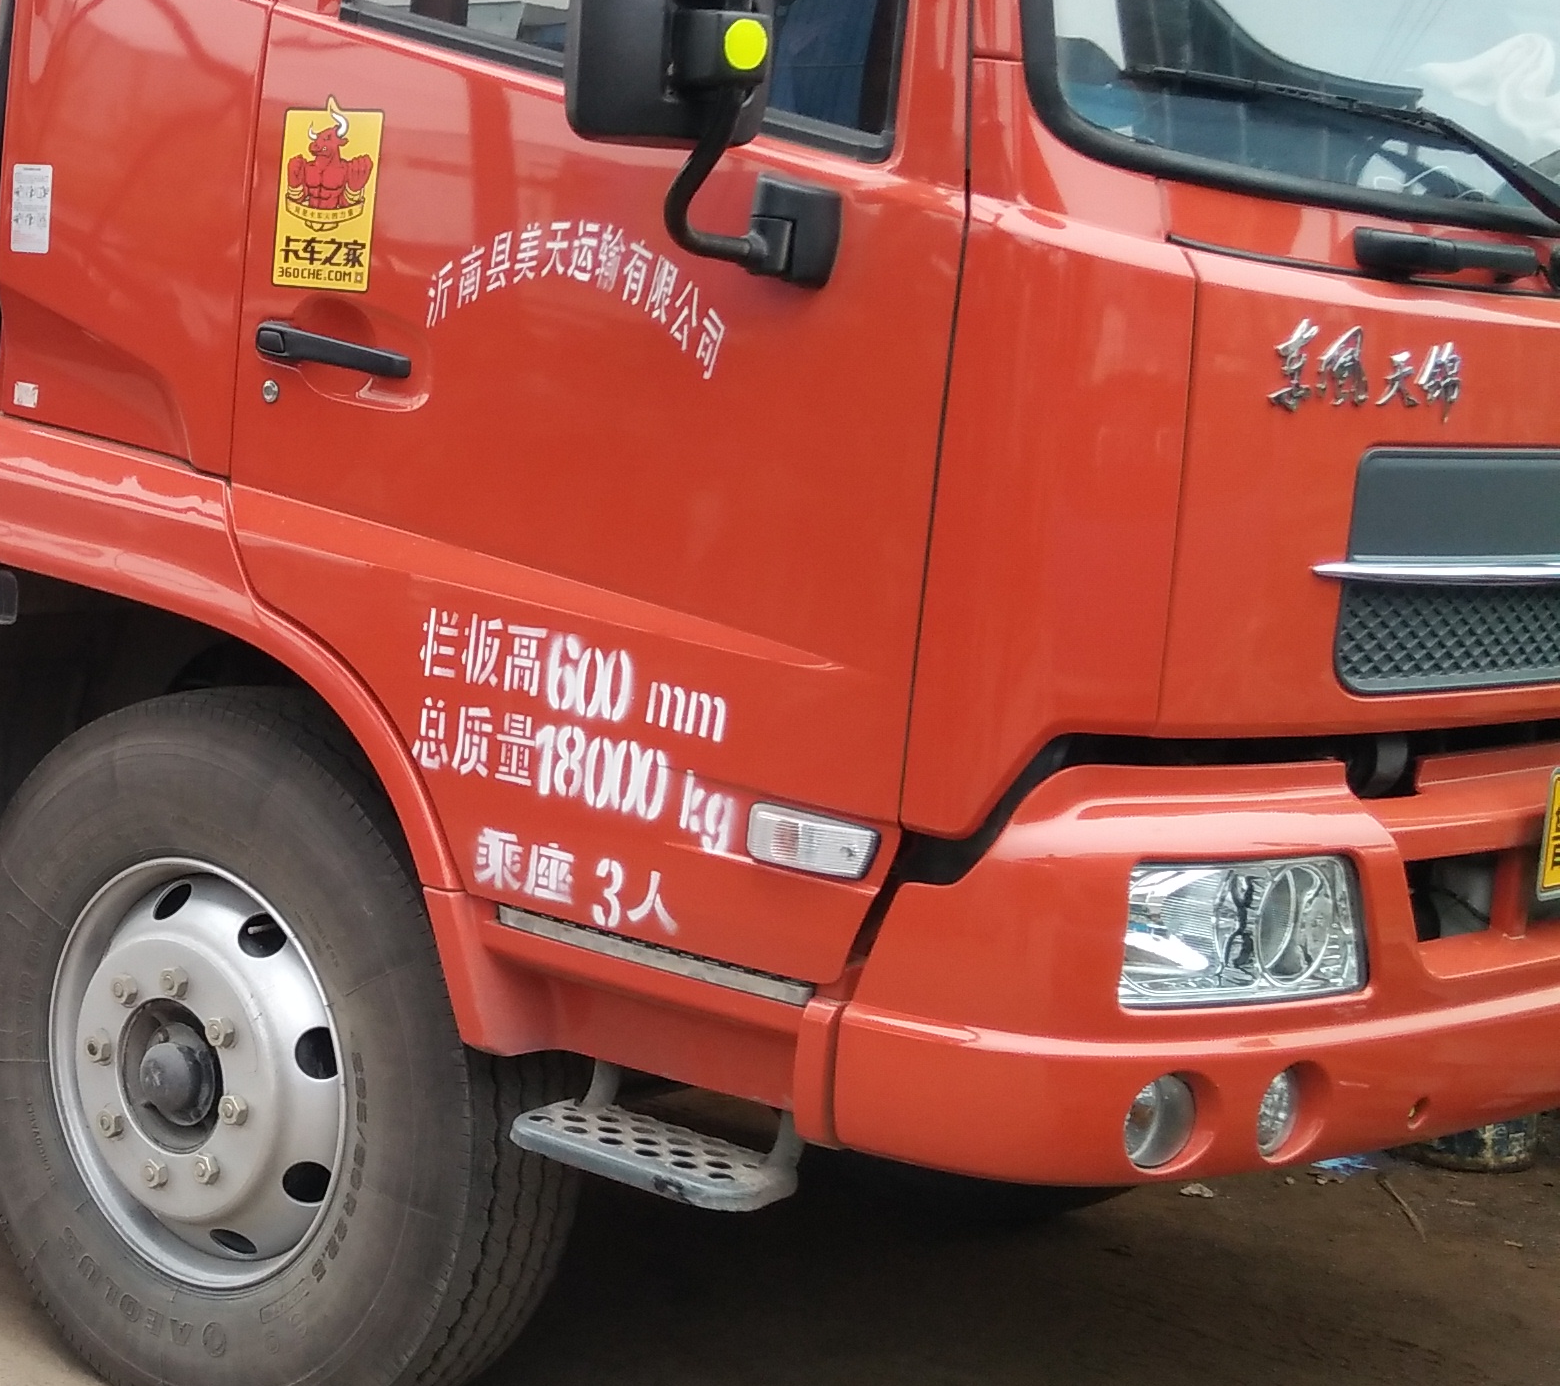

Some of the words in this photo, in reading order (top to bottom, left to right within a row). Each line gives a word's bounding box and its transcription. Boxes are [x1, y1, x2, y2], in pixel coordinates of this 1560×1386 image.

[277, 266, 352, 283] 360CHE.COM
[280, 235, 367, 269] 卡车之家
[426, 219, 726, 380] 沂南县美天运输有限公司
[644, 680, 727, 744] mm
[678, 769, 737, 855] kg
[473, 826, 575, 905] 乘座
[58, 1225, 194, 1347] AEOLUS
